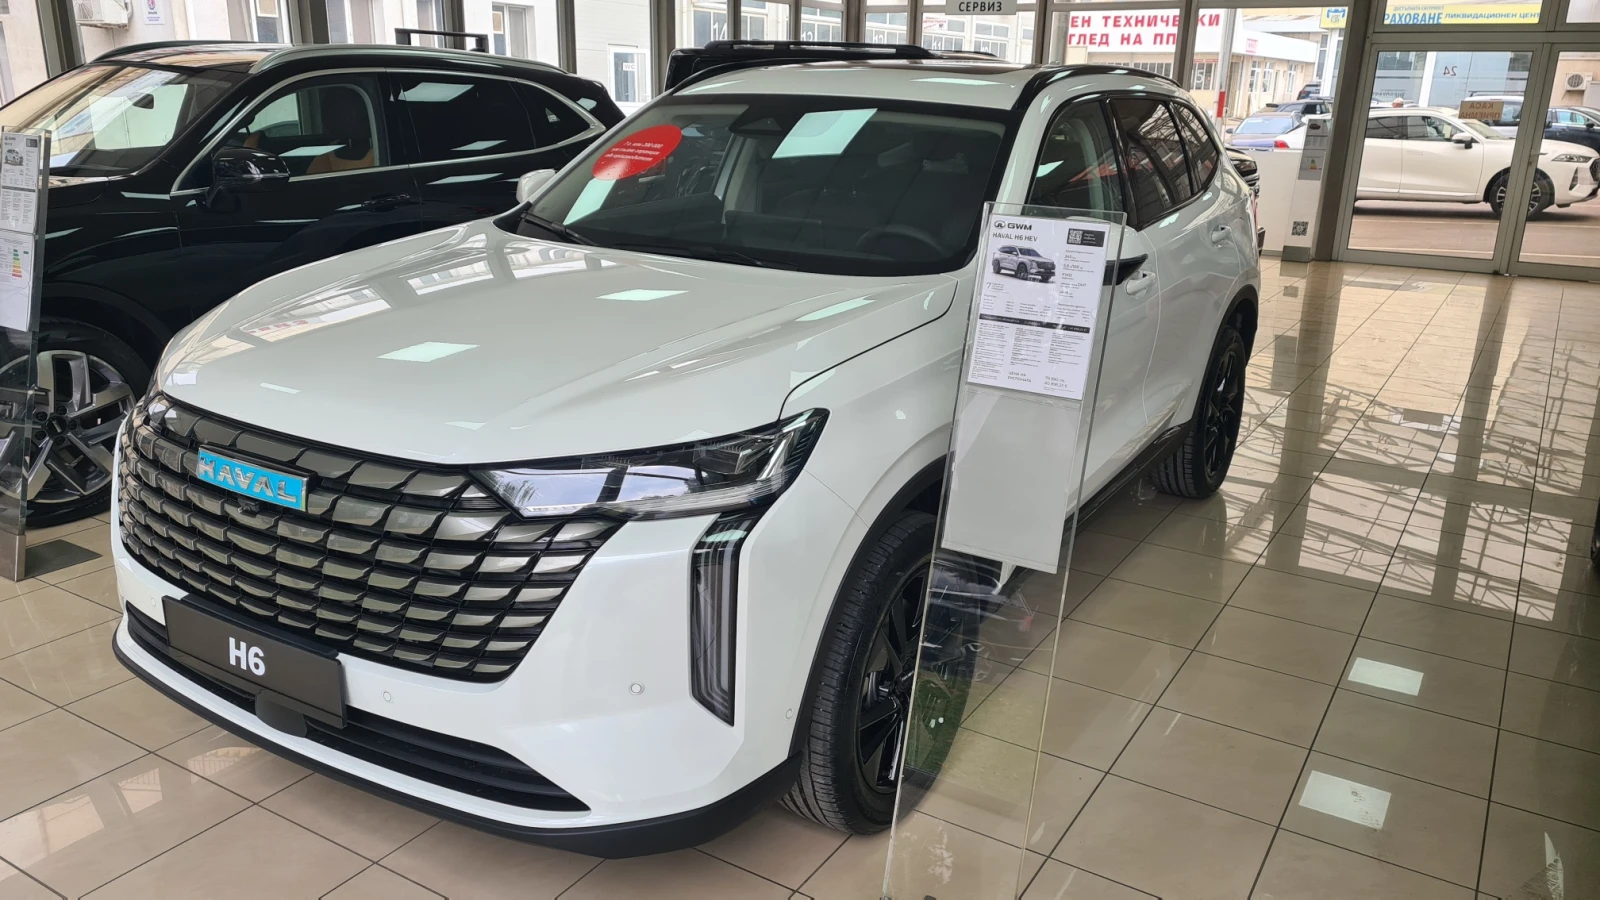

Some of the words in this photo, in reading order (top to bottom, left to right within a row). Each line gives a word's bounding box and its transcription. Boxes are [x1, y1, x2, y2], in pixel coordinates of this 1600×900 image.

[958, 1, 1002, 12] СЕРВИЗ
[1102, 14, 1220, 28] ТЕХНИЧЕКИ
[1120, 33, 1143, 45] НА
[1007, 222, 1033, 231] GWM
[992, 231, 1014, 240] HAVAL
[198, 456, 297, 503] HAVAL
[229, 636, 266, 676] H6
